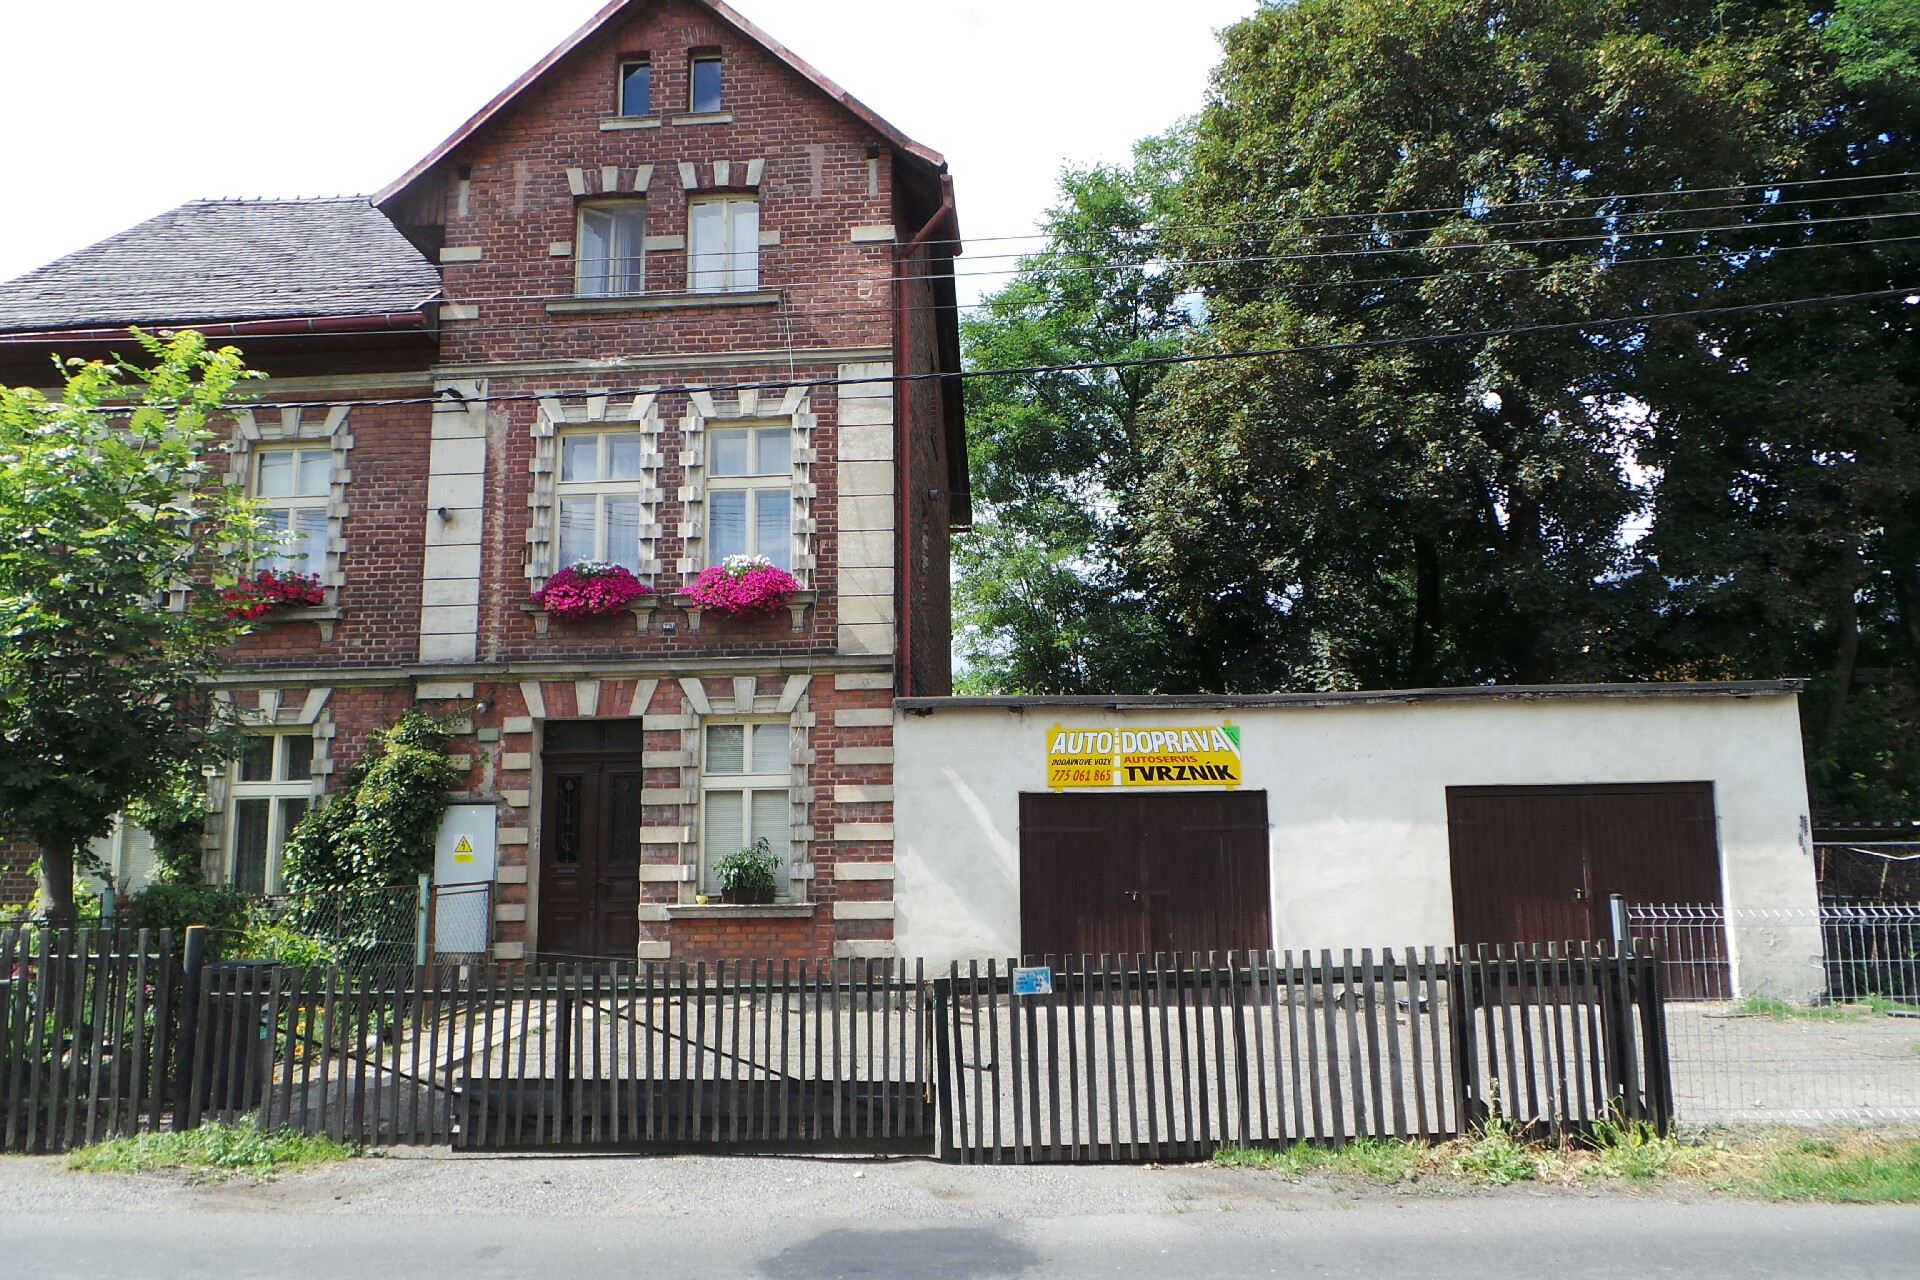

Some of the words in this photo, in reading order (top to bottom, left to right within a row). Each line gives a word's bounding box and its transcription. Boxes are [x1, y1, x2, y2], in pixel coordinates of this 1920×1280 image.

[1050, 731, 1113, 754] AUTO
[1121, 730, 1231, 753] DOPRAVA
[1094, 758, 1112, 766] VOZY
[1051, 769, 1071, 781] 775
[1073, 769, 1091, 781] 061
[1093, 769, 1111, 781] 865
[1124, 761, 1238, 781] TVRZNÍK
